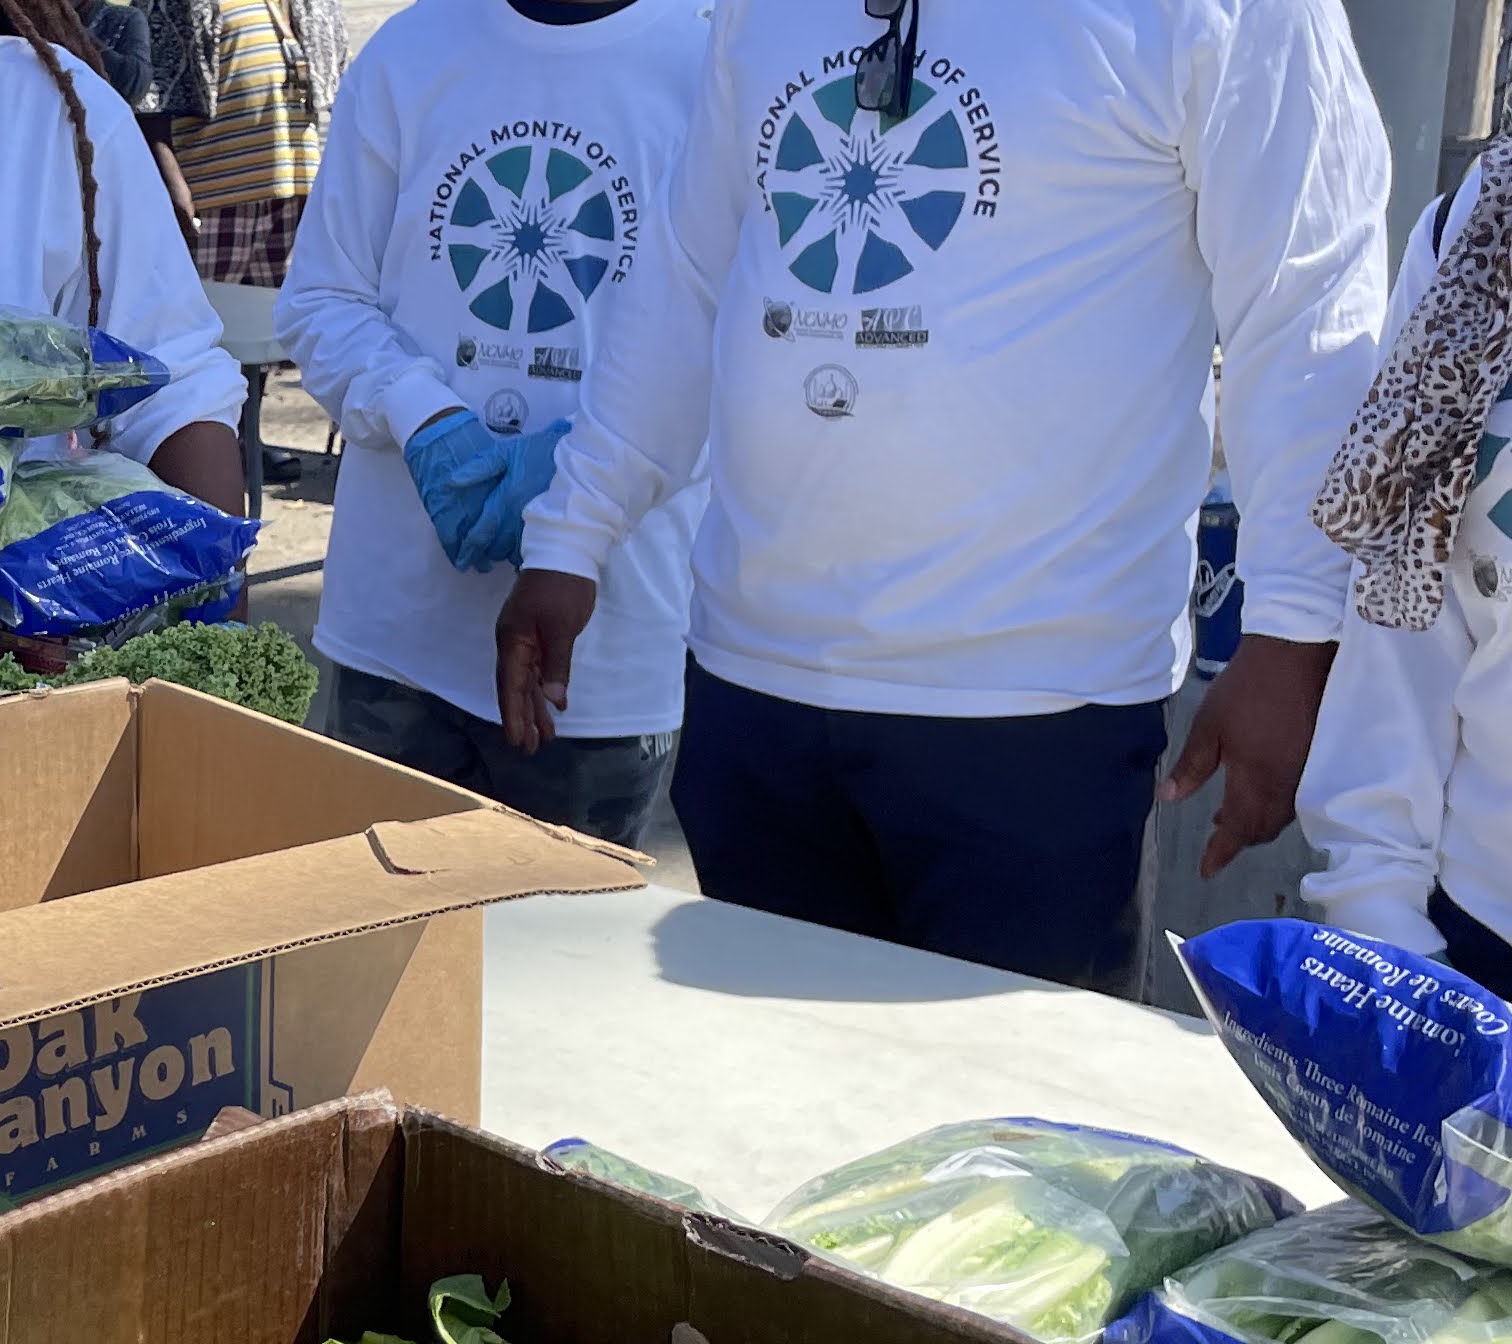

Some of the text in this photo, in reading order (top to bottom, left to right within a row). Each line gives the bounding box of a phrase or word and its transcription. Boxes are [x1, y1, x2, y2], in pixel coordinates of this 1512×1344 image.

[930, 57, 966, 85] OF
[959, 88, 1000, 218] SERVICE
[429, 120, 638, 284] NATIONAL MONTH OF SERVICE
[1300, 956, 1377, 1009] Hearts
[1313, 928, 1411, 987] Romaine
[1408, 974, 1439, 999] de
[1303, 1058, 1345, 1096] Three
[1346, 1082, 1410, 1134] Romaine
[1335, 1104, 1354, 1124] de
[4, 1109, 188, 1196] FARMS
